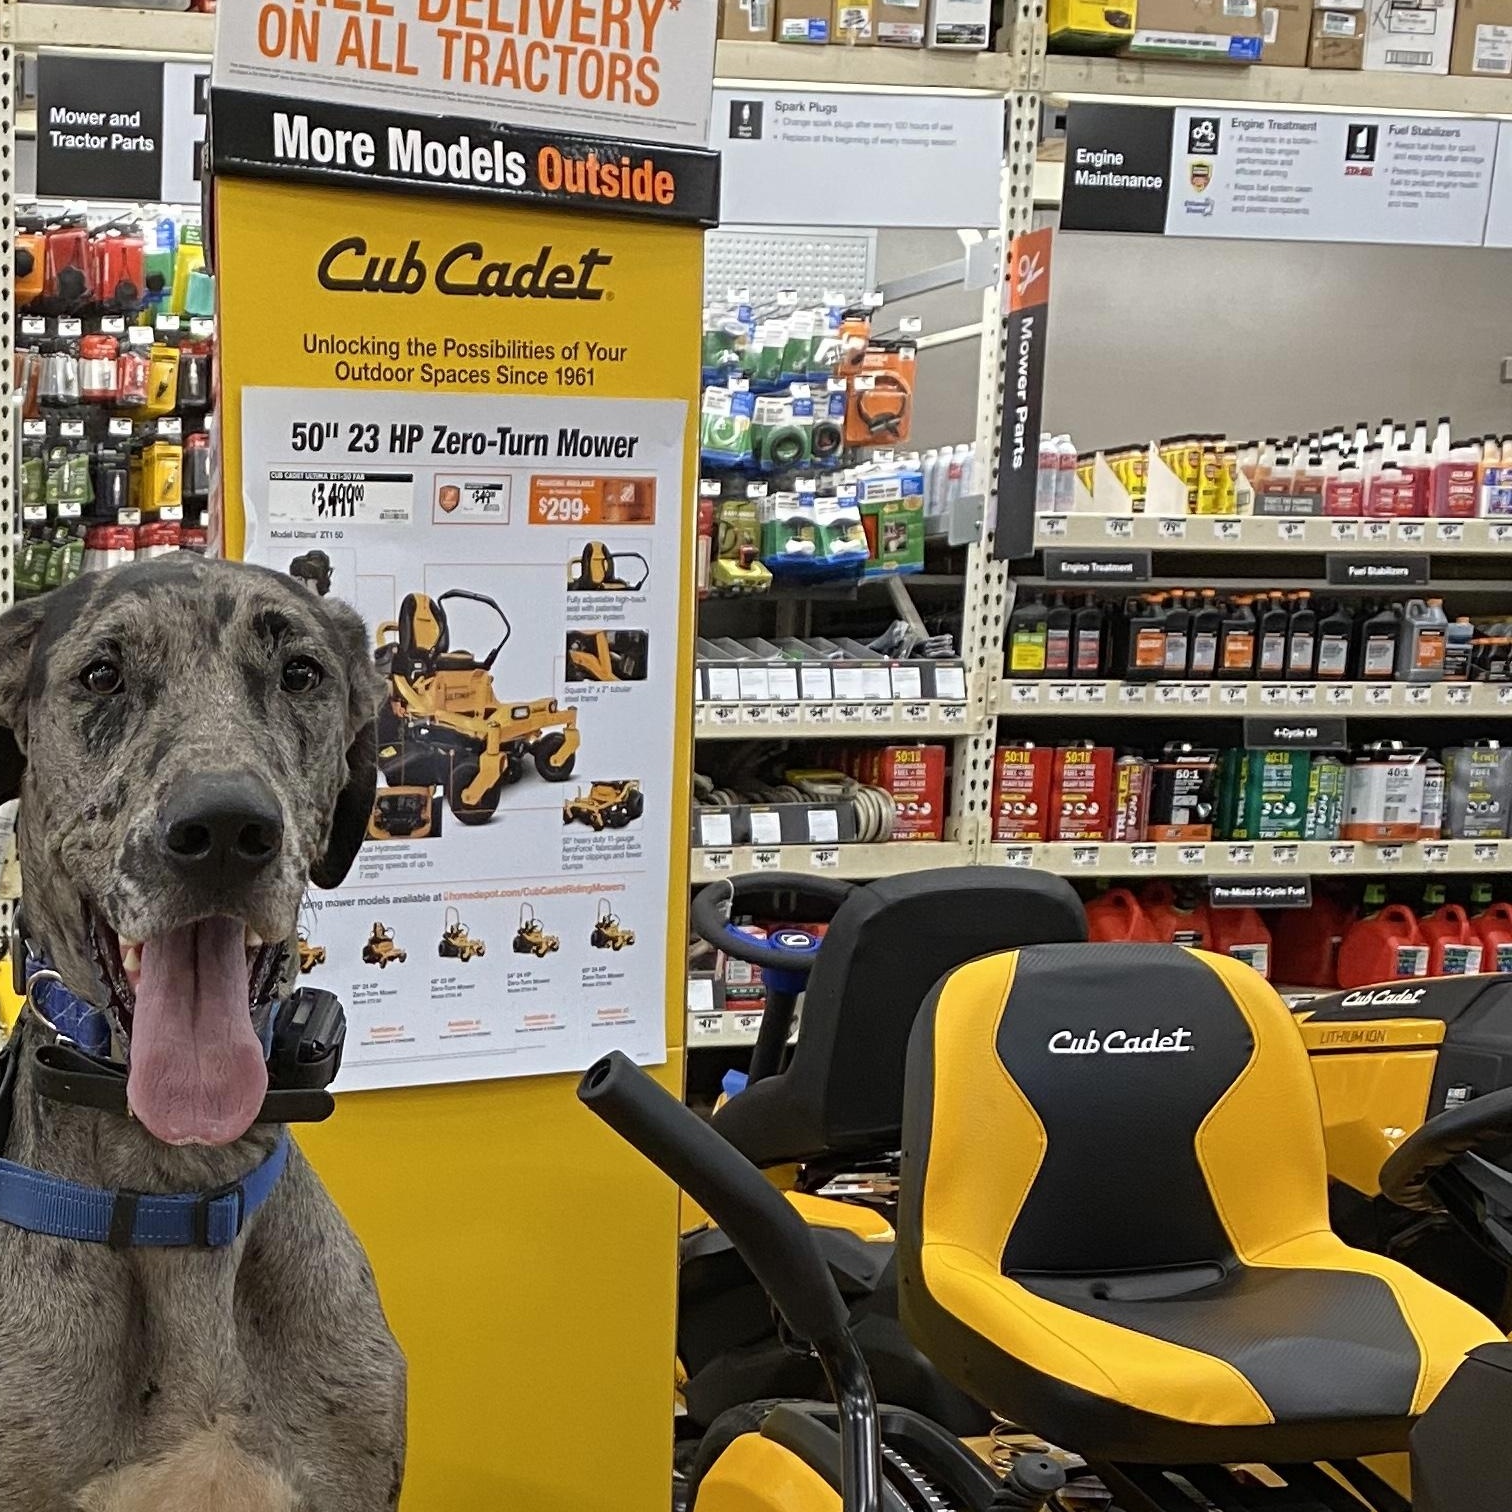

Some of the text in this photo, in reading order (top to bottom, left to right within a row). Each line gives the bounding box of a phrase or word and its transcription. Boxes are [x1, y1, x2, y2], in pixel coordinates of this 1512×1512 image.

[258, 4, 319, 62] ON
[336, 16, 418, 76] ALL
[436, 27, 660, 106] TRACTORS
[49, 107, 140, 127] Mower and
[775, 101, 838, 114] Spark Plugs
[1232, 117, 1318, 132] Engine Treatment
[1389, 124, 1462, 138] Fuel Stabilizers
[49, 130, 155, 151] Tractor Parts
[272, 113, 676, 205] More Models Outside
[1076, 147, 1125, 168] Engine
[1074, 169, 1164, 190] Maintenance
[317, 236, 614, 302] Cub Cadet
[303, 333, 628, 363] Unlocking the Possibilities of Your
[334, 360, 597, 389] Outdoor Spaces Since 1961
[1012, 316, 1034, 470] Mower Parts
[291, 422, 639, 459] 50" 23 HP Zero-Turn Mower
[312, 482, 366, 519] $3,49900
[538, 497, 591, 522] $299+
[270, 530, 292, 539] Model
[1061, 560, 1134, 573] Engine Treatment
[1348, 565, 1409, 577] Fuel Stabilizers
[1273, 727, 1318, 739] 4-Cycle Oil
[302, 899, 324, 912] ding
[325, 897, 356, 907] mower
[357, 895, 391, 907] models
[392, 892, 433, 905] available
[434, 892, 443, 902] at
[1256, 886, 1287, 898] 2-Cycle
[1287, 886, 1306, 897] Fuel
[1341, 987, 1427, 1006] Cub Cadet
[1047, 1026, 1194, 1055] Cub Cadet
[1319, 1028, 1386, 1045] LITHIUM ION
